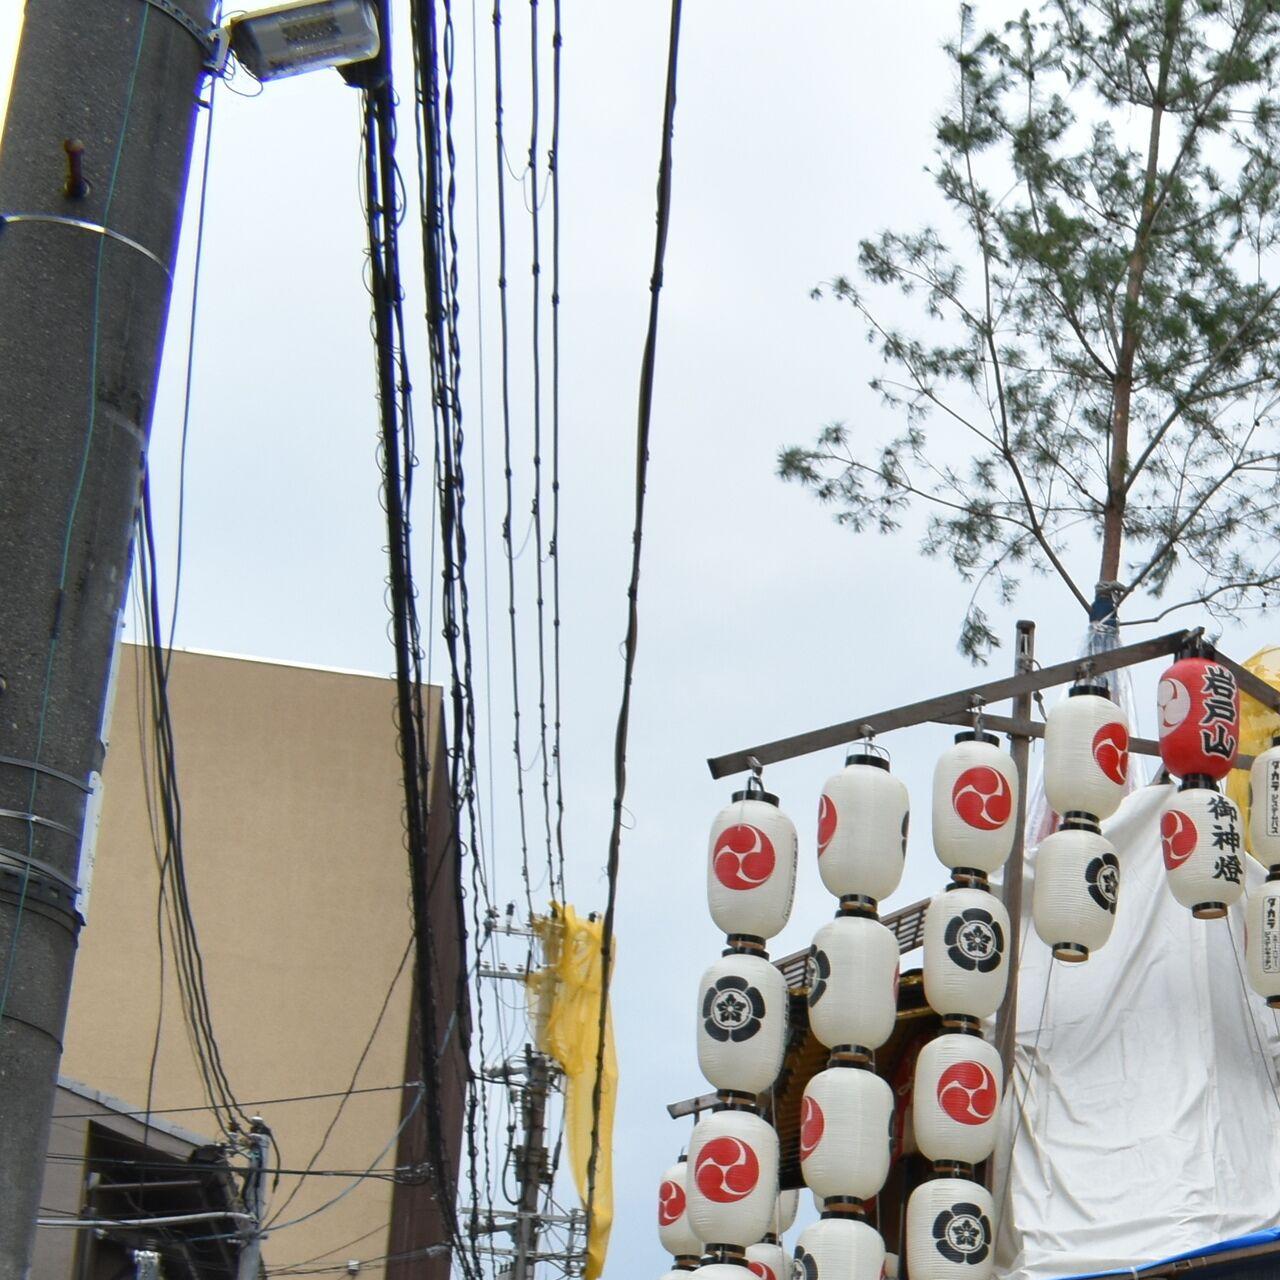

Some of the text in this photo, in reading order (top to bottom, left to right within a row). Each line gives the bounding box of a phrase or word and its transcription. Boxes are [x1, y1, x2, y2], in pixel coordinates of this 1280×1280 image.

[1200, 663, 1238, 760] 岩戸山
[1207, 795, 1245, 885] 御神燈
